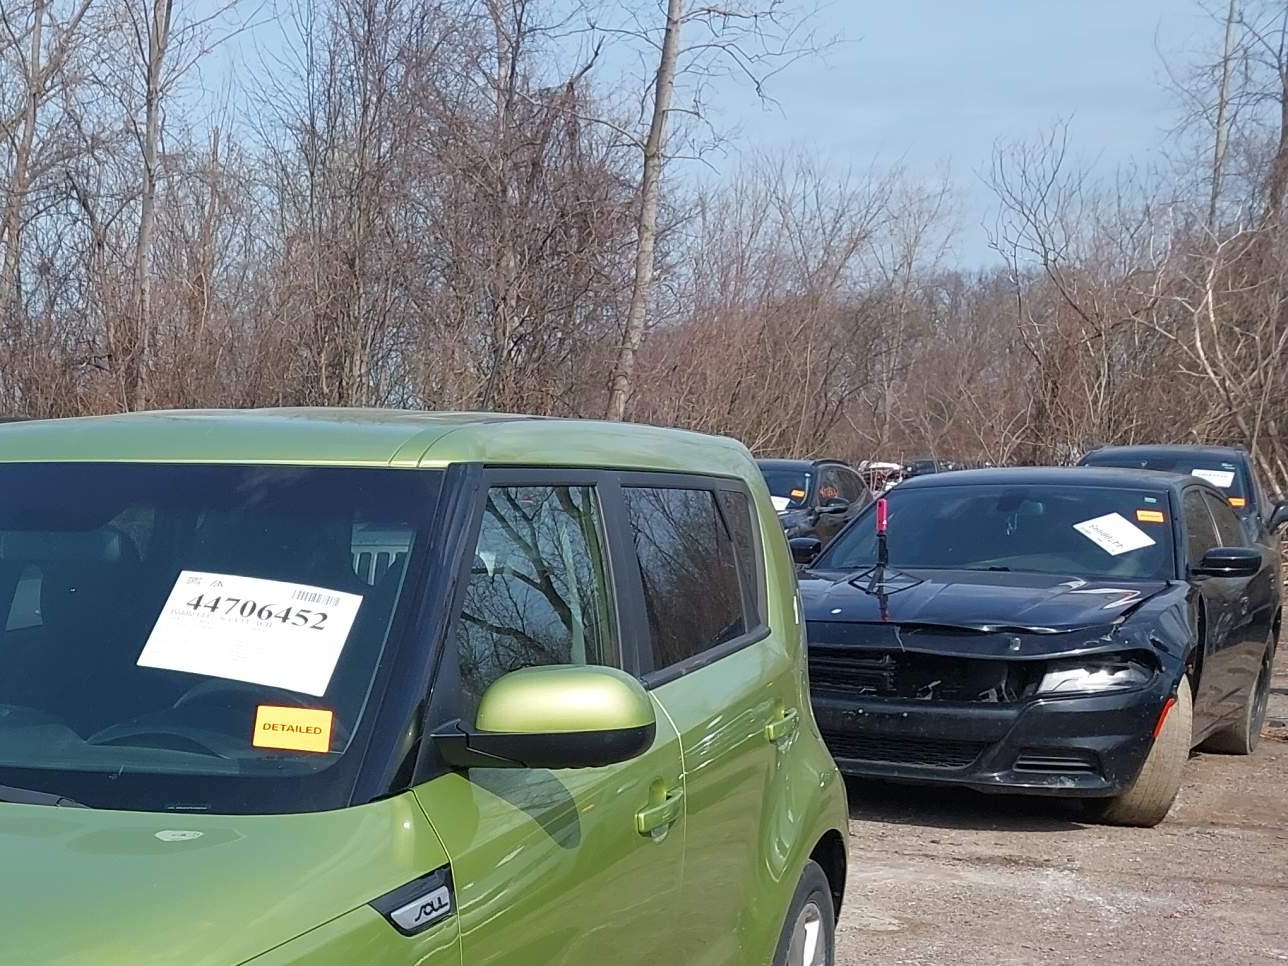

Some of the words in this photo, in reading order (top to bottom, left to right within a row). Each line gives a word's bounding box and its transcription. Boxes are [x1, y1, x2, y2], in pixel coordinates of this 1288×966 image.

[186, 593, 329, 631] 44706452
[261, 722, 322, 735] DETAILED
[413, 896, 449, 922] SOUL
